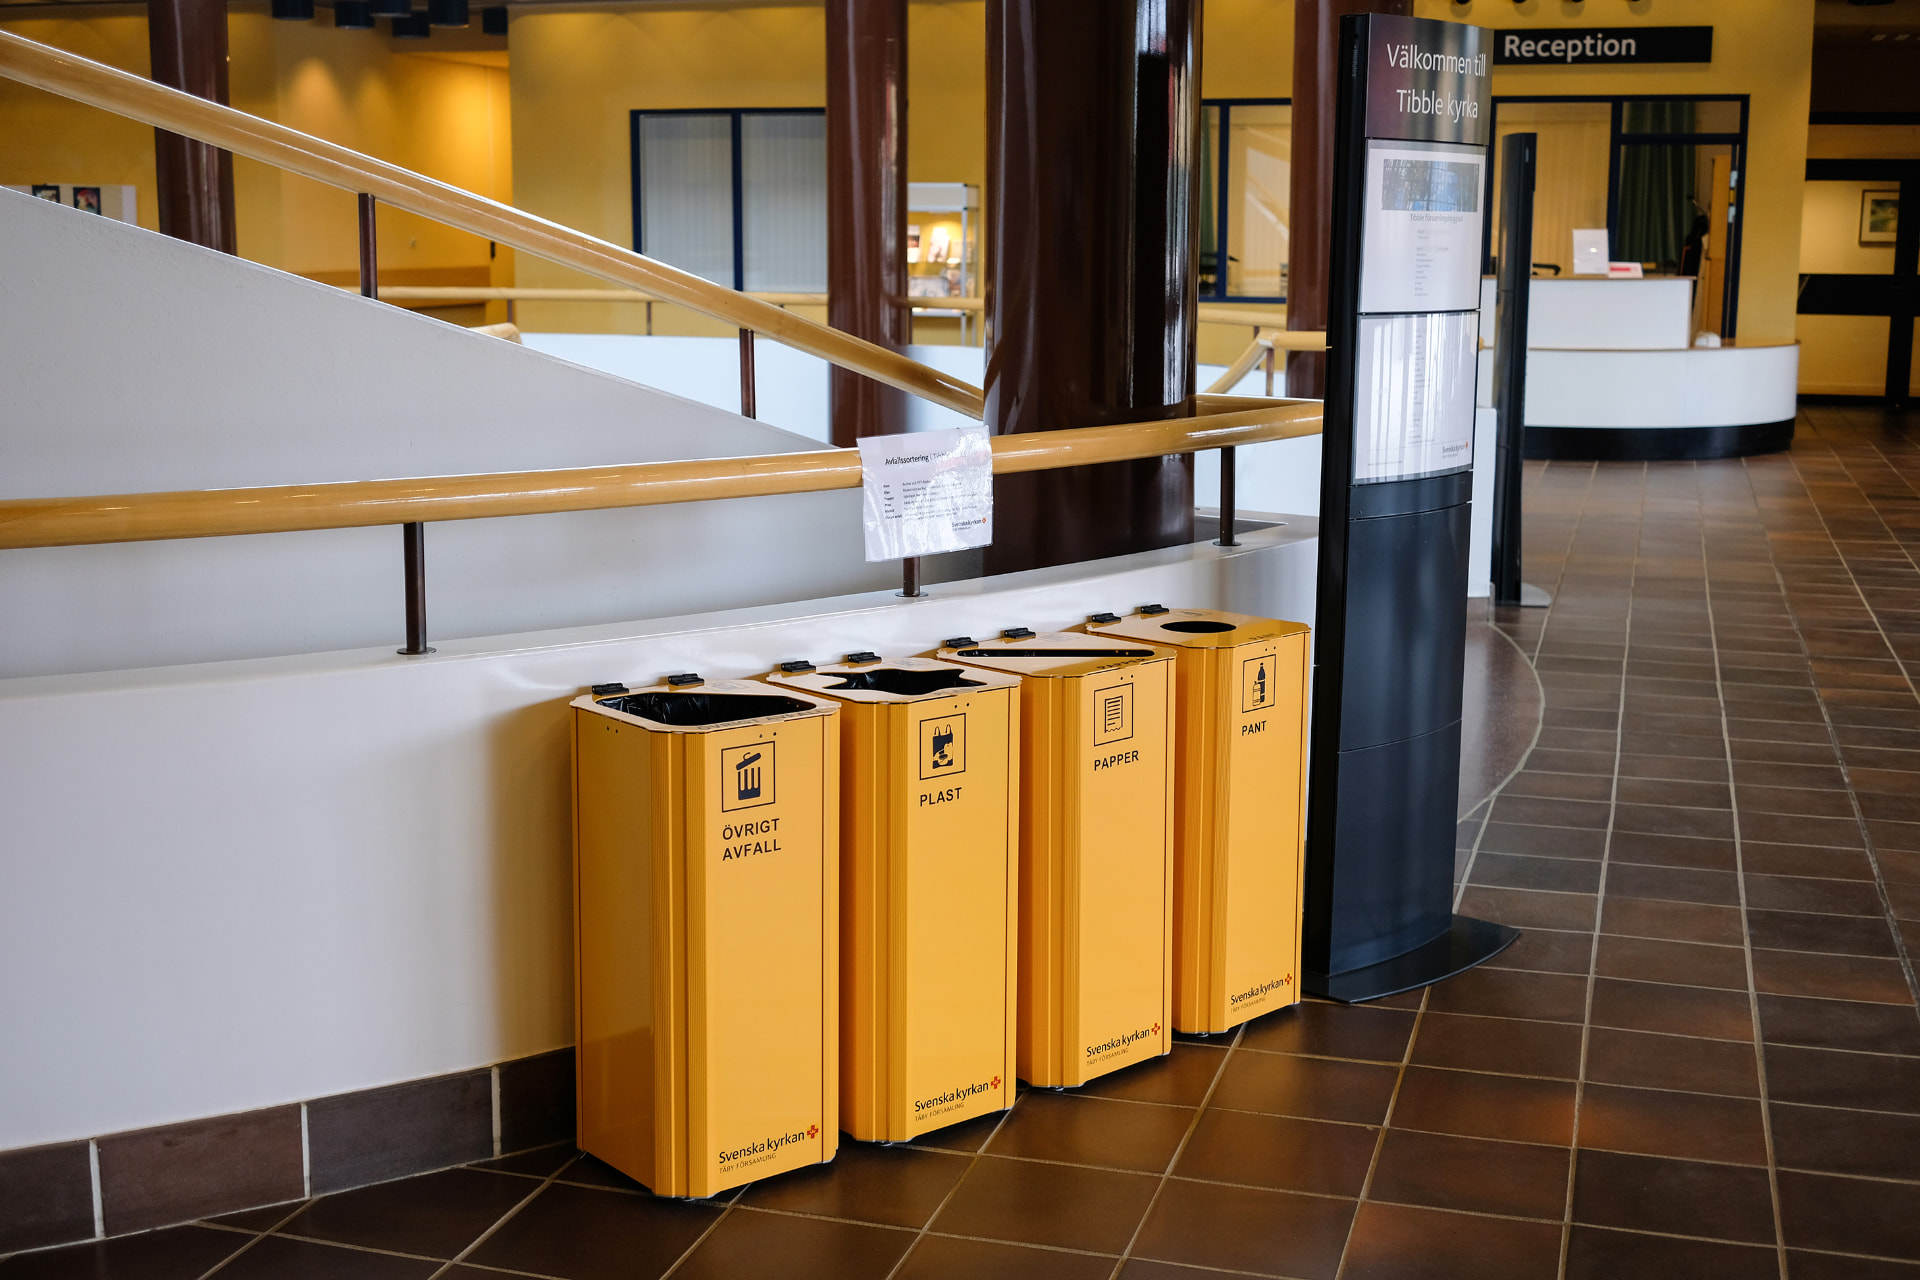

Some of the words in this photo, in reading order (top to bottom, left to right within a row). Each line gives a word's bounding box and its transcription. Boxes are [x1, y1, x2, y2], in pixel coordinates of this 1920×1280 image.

[1387, 43, 1472, 75] Välkommen
[1474, 53, 1486, 77] till
[1504, 33, 1636, 63] Reception
[1396, 89, 1443, 115] Tibble
[1447, 91, 1478, 123] kyrka
[1241, 720, 1267, 736] PANT
[1094, 750, 1139, 771] PAPPER
[920, 787, 962, 807] PLAST
[722, 818, 780, 840] ÖVRIGT
[722, 839, 781, 861] AVFALL
[1230, 987, 1260, 1005] Svenska
[1260, 979, 1284, 996] kyrkan
[1086, 1038, 1121, 1058] Svenska
[1121, 1029, 1150, 1047] kyrkan
[914, 1092, 955, 1112] Svenska
[956, 1082, 989, 1101] kyrkan
[929, 1102, 965, 1117] FÖRSAMLING
[719, 1142, 765, 1164] Svenska
[767, 1131, 805, 1152] kyrkan
[719, 1164, 735, 1174] TÄBY
[736, 1152, 777, 1169] FÖRSAMLING
